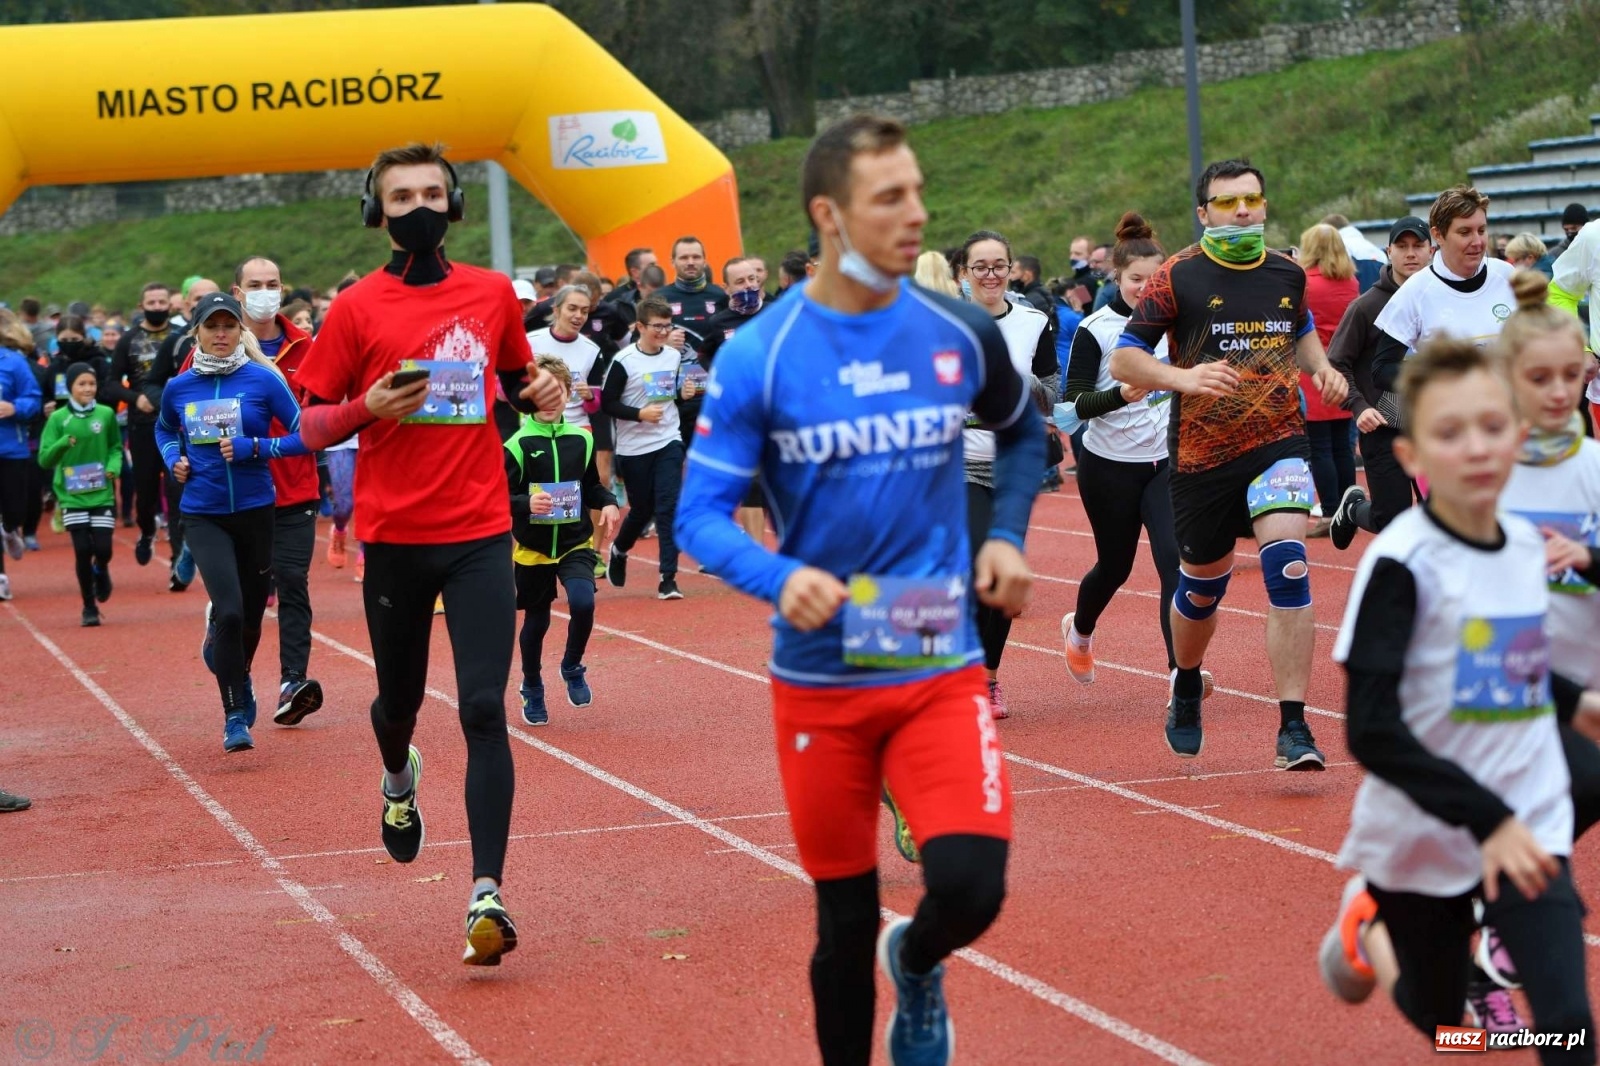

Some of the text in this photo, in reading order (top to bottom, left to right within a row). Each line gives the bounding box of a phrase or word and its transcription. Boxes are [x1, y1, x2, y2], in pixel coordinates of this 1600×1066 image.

[97, 69, 443, 119] MIASTO RACIBÓRZ
[1211, 321, 1292, 335] PIERUNSKIE
[1219, 335, 1286, 351] CANGÓRY
[450, 403, 479, 416] 350
[220, 426, 237, 436] 115
[1287, 491, 1309, 503] 174
